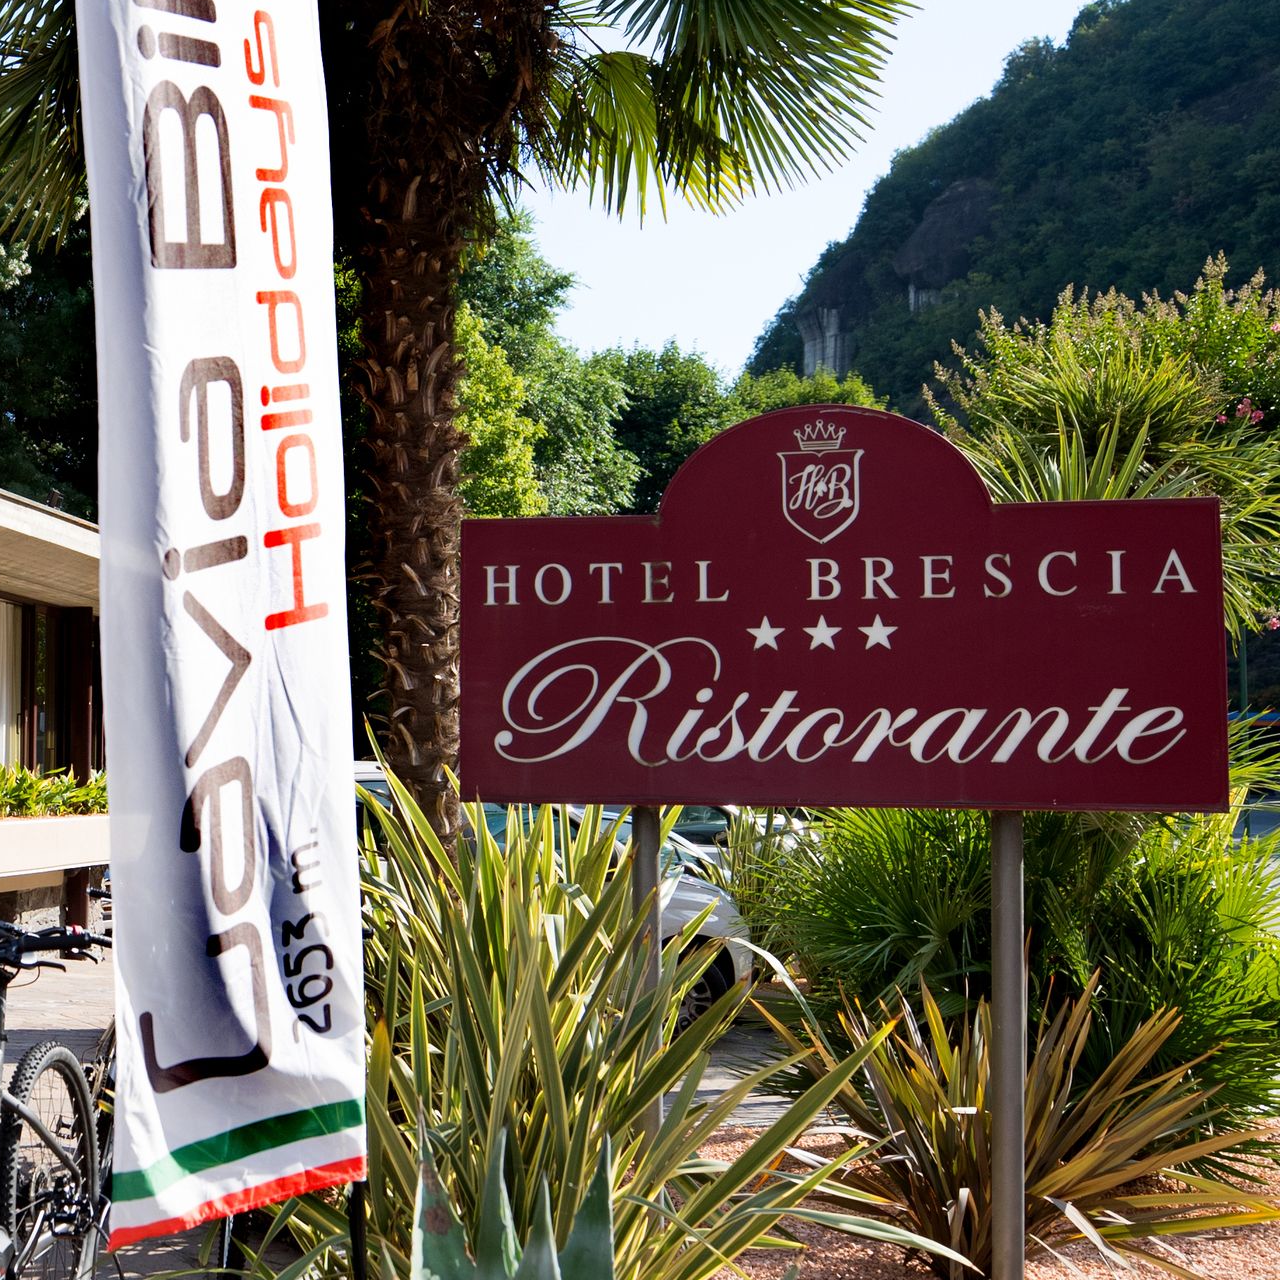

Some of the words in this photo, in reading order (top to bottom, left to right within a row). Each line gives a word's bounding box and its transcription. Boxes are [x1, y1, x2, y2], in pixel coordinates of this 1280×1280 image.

[484, 560, 730, 605] HOTEL
[807, 549, 1198, 600] BRESCIA
[138, 356, 273, 1093] Gavia
[494, 637, 1187, 766] Ristorante
[280, 911, 334, 1044] 2653
